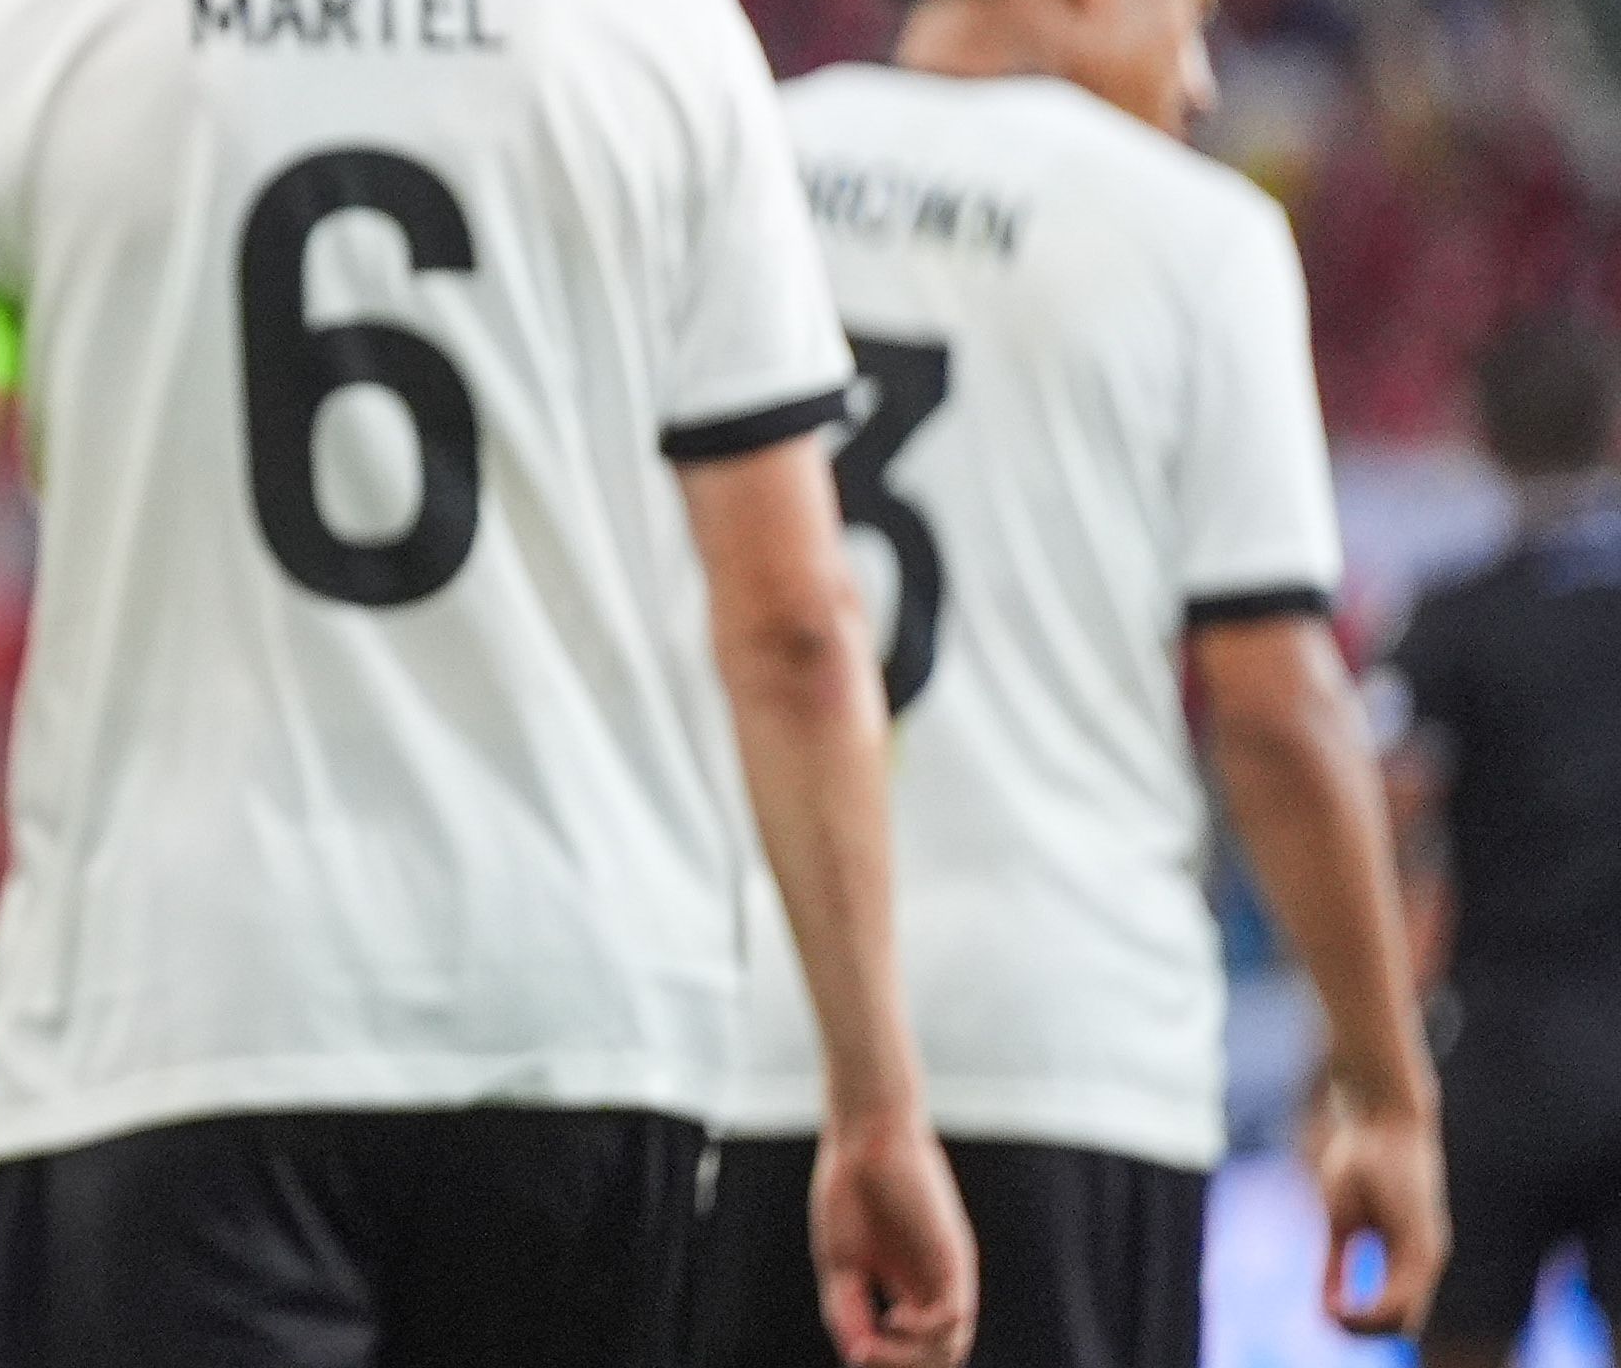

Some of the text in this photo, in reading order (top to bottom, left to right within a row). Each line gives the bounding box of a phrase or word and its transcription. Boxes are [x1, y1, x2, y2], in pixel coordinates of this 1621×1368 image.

[240, 143, 481, 606] 6
[799, 154, 1029, 264] ROWN
[831, 334, 949, 720] 3
